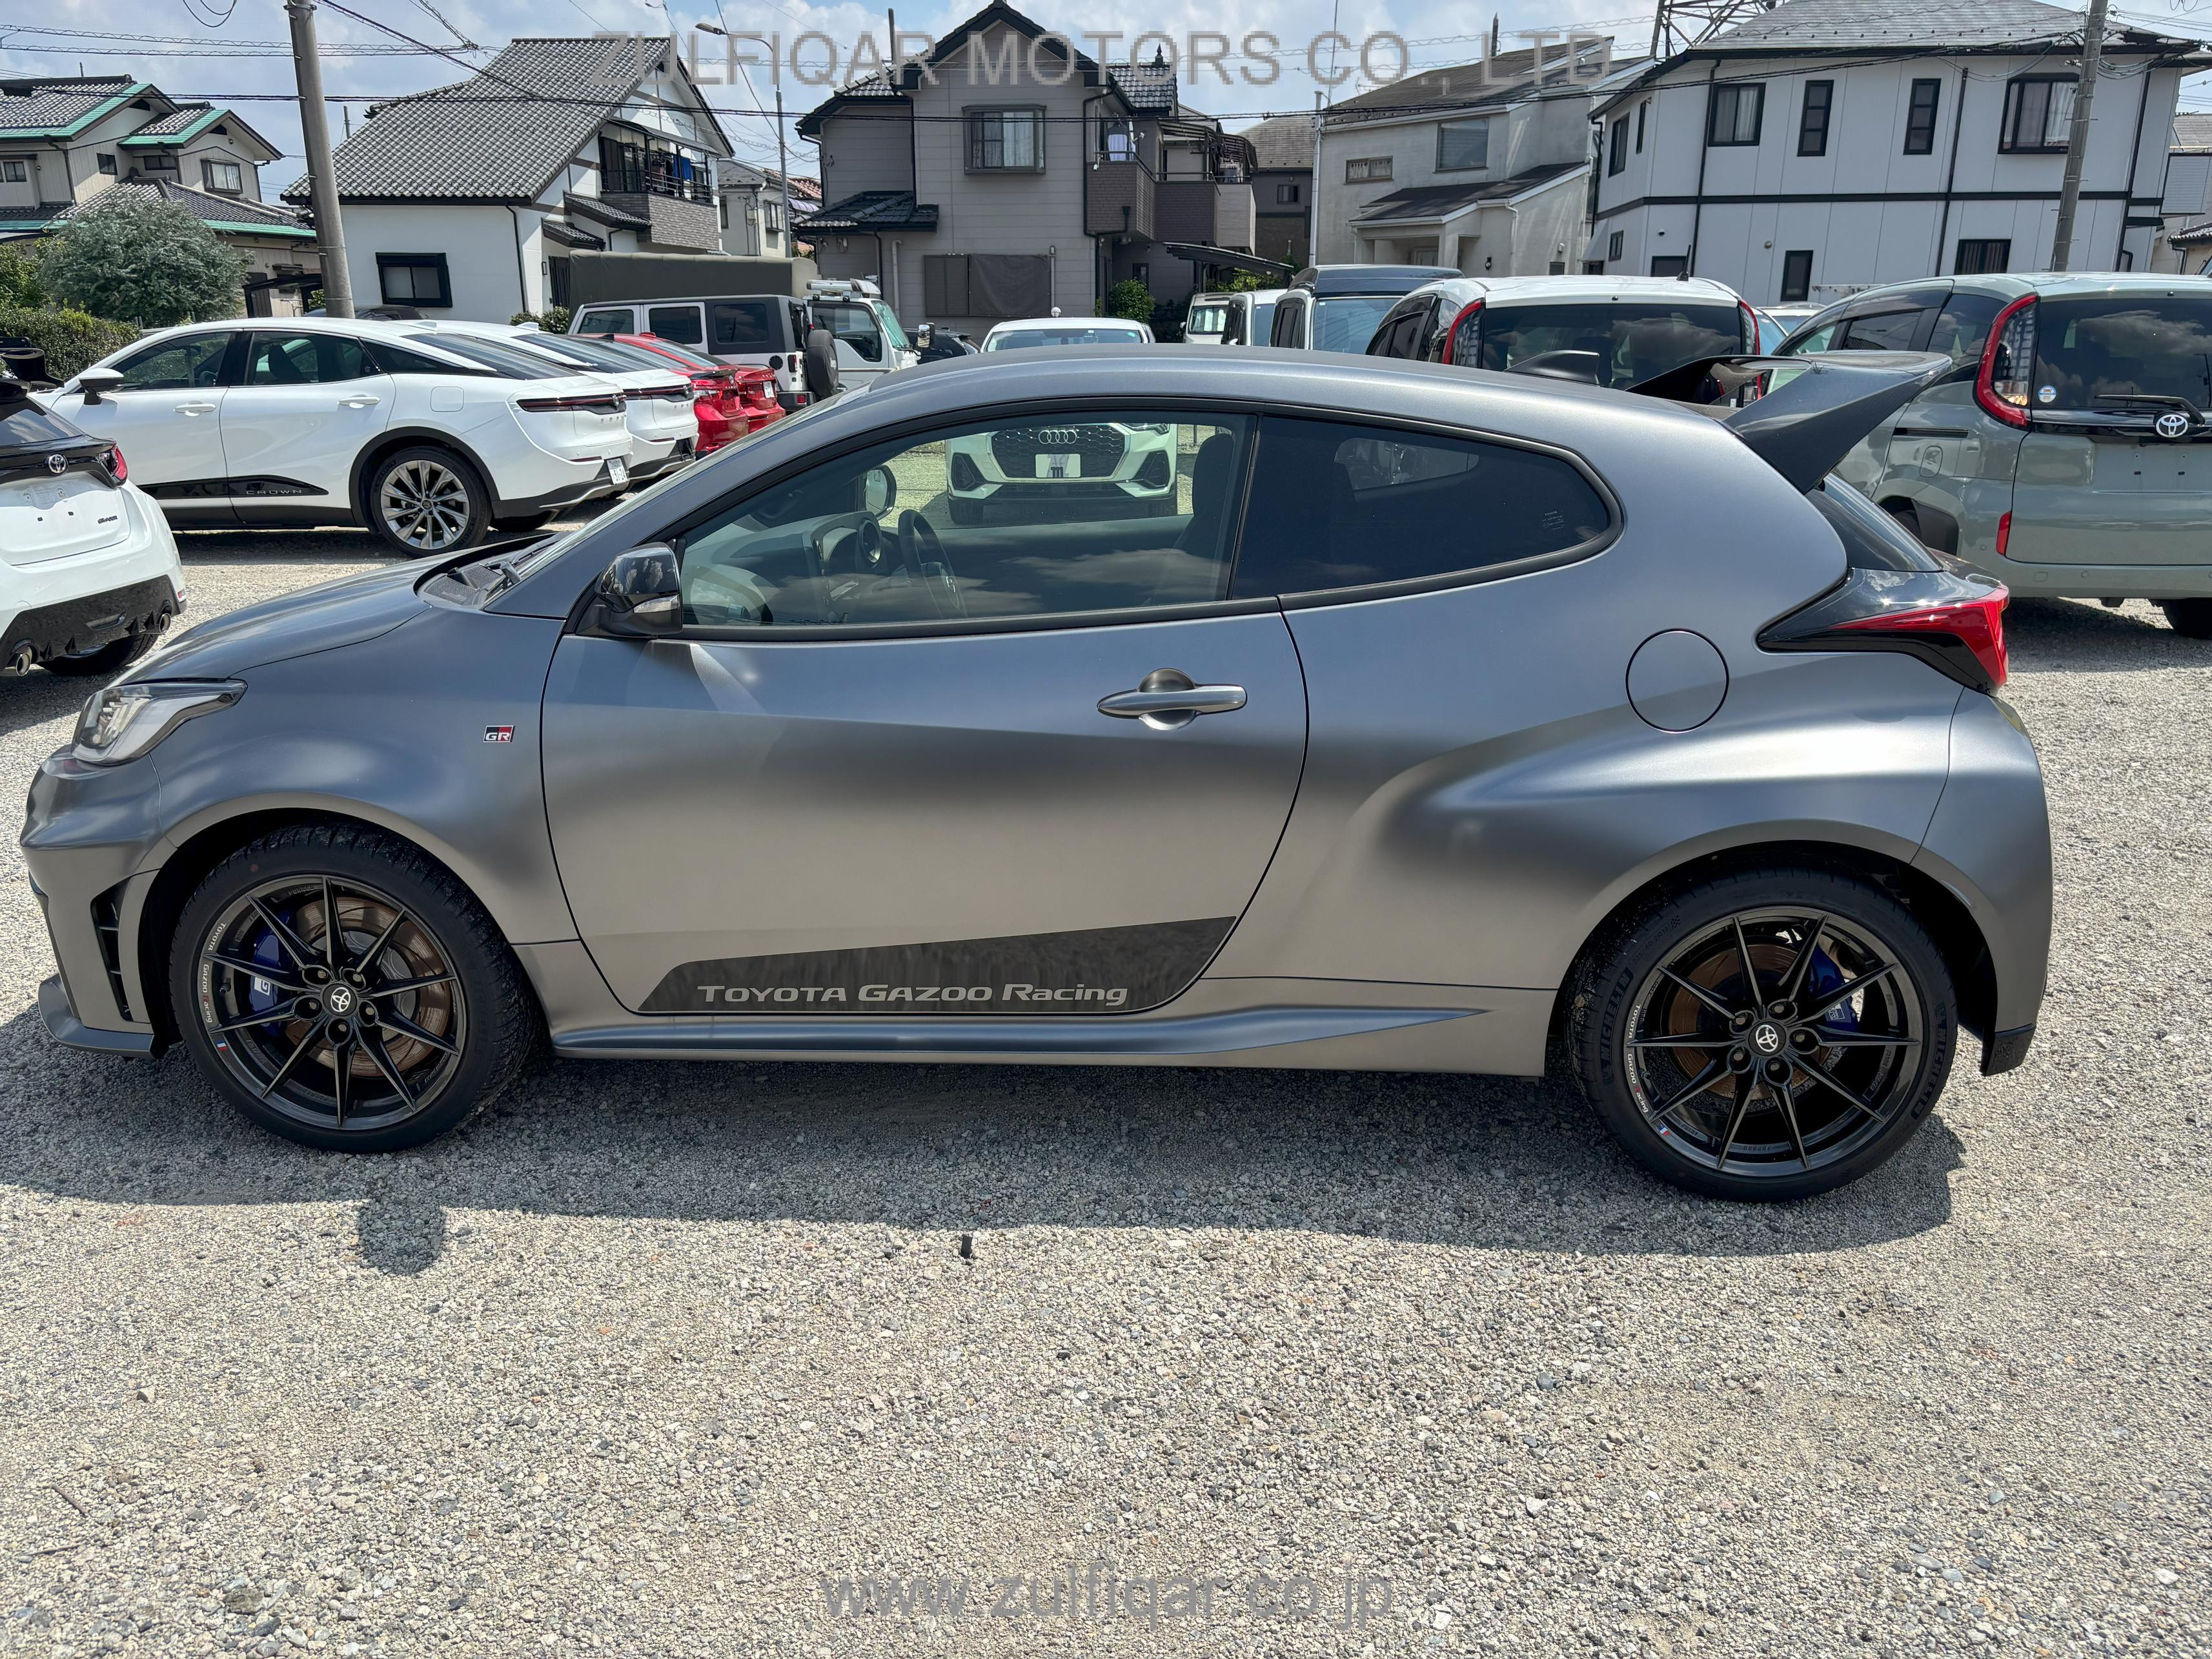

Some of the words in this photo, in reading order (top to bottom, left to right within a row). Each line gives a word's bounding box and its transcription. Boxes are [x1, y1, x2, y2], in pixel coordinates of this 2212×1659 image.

[208, 923, 227, 950] TOYOTA
[697, 985, 847, 1002] TOYOTA
[858, 984, 993, 1001] GAZOO
[1002, 982, 1128, 1006] Racing
[203, 995, 212, 1023] Racing
[1601, 970, 1630, 1064] MICHELIN
[1629, 1004, 1641, 1039] TOYOTA
[1628, 1053, 1636, 1084] GAZOO
[1914, 1028, 1947, 1115] MICHELIN
[1634, 1086, 1649, 1113] Racing
